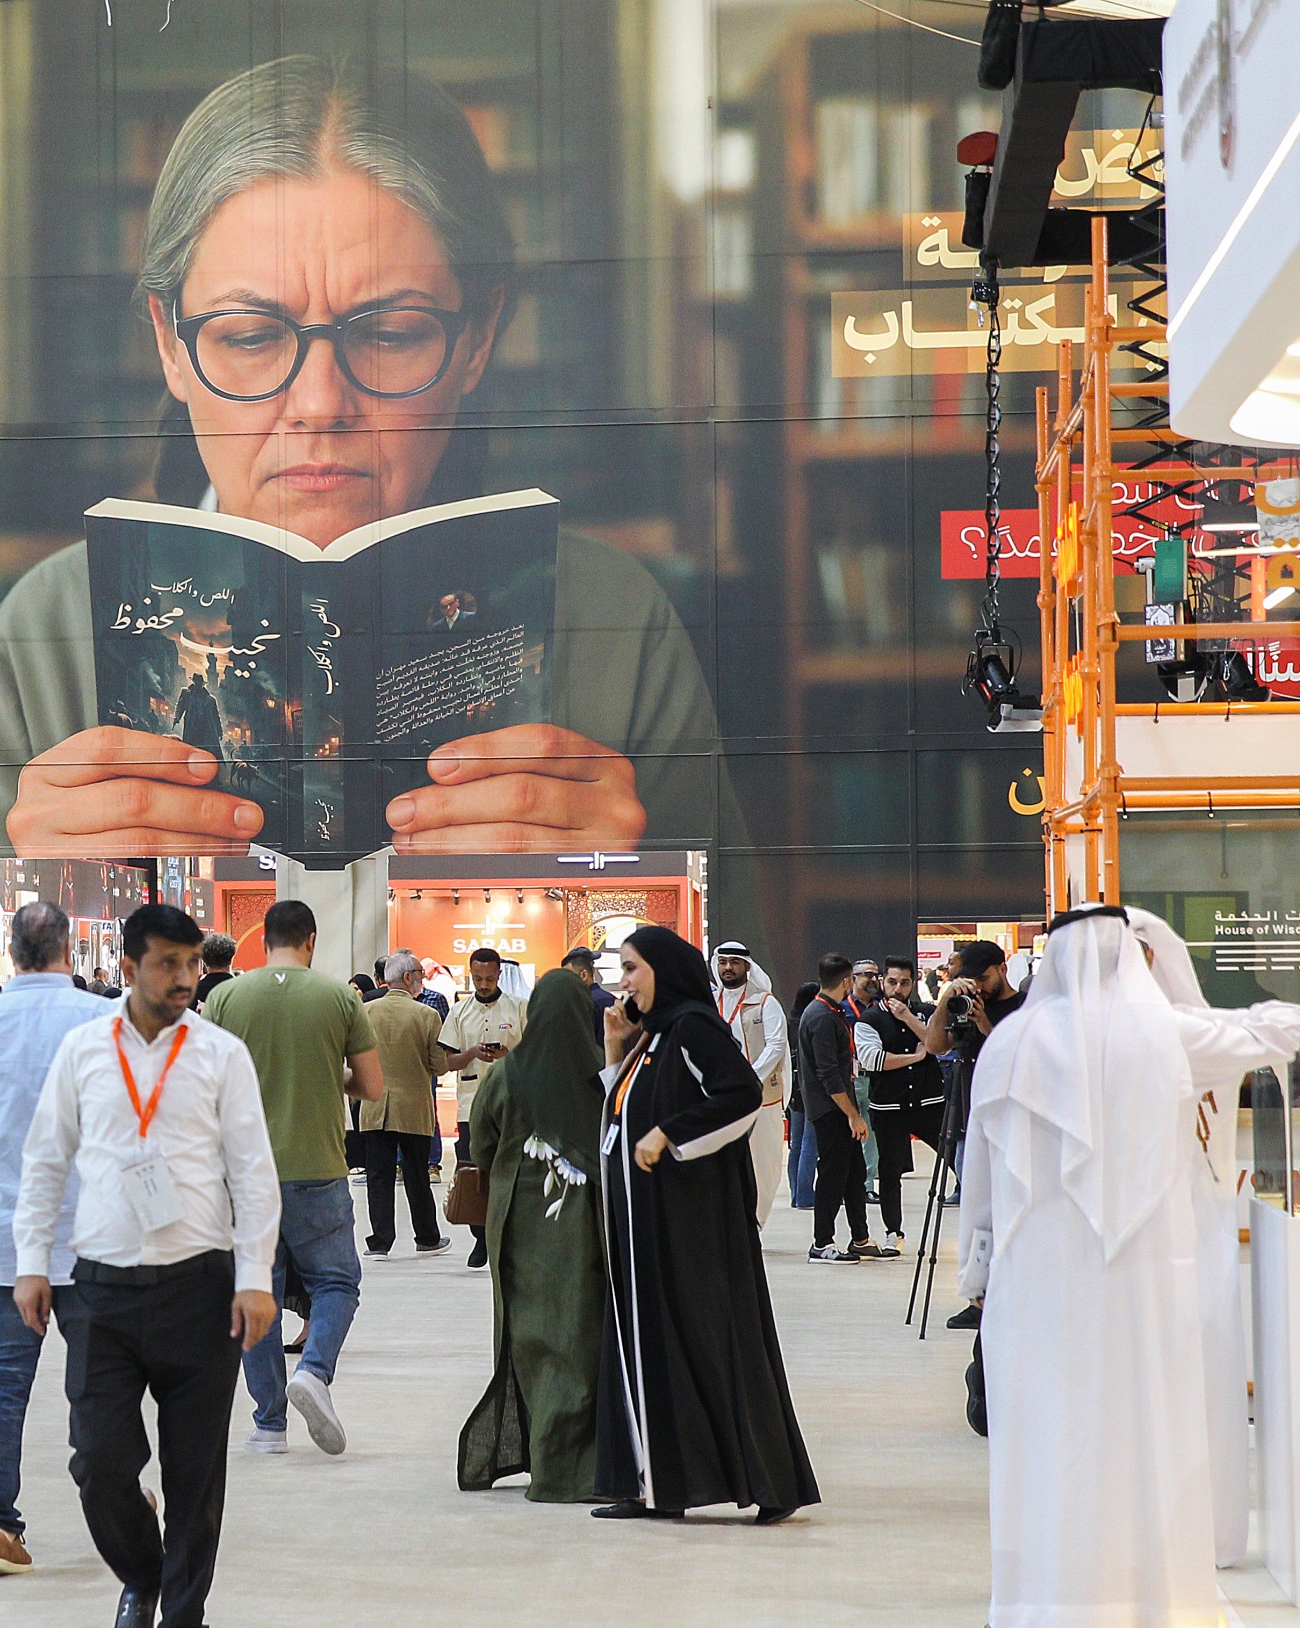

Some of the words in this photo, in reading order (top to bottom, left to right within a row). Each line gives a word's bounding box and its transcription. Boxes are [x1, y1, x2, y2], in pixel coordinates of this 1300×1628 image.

[150, 578, 198, 598] والكلاب
[200, 588, 235, 607] اللص
[110, 597, 184, 635] محفوظ
[310, 598, 342, 638] اللص
[180, 618, 281, 679] نجيب
[1214, 910, 1278, 922] الحكمة
[1214, 924, 1254, 935] House
[1256, 924, 1269, 935] of
[453, 938, 527, 954] SARAB
